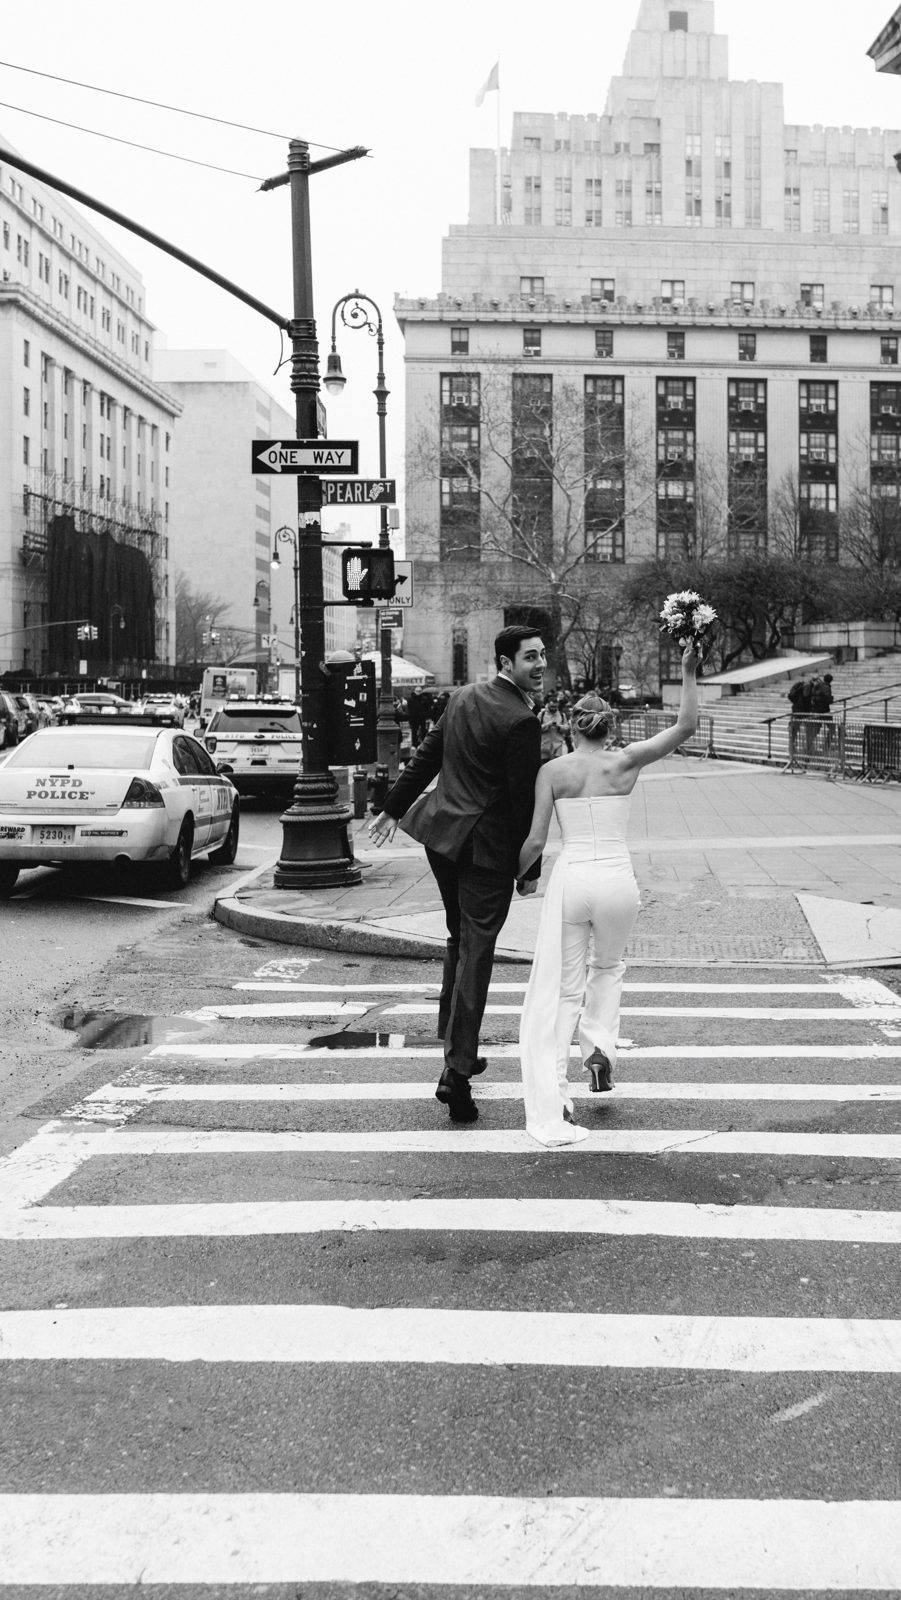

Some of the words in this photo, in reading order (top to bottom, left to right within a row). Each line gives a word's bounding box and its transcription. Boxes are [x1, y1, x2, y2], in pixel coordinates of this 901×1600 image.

[268, 450, 298, 464] ONE
[313, 450, 345, 464] WAY
[327, 482, 371, 502] PEARL
[377, 482, 392, 493] ST
[390, 596, 411, 604] ONLY
[36, 778, 83, 787] NYPD
[26, 790, 88, 800] POLICE
[40, 830, 63, 840] 5230
